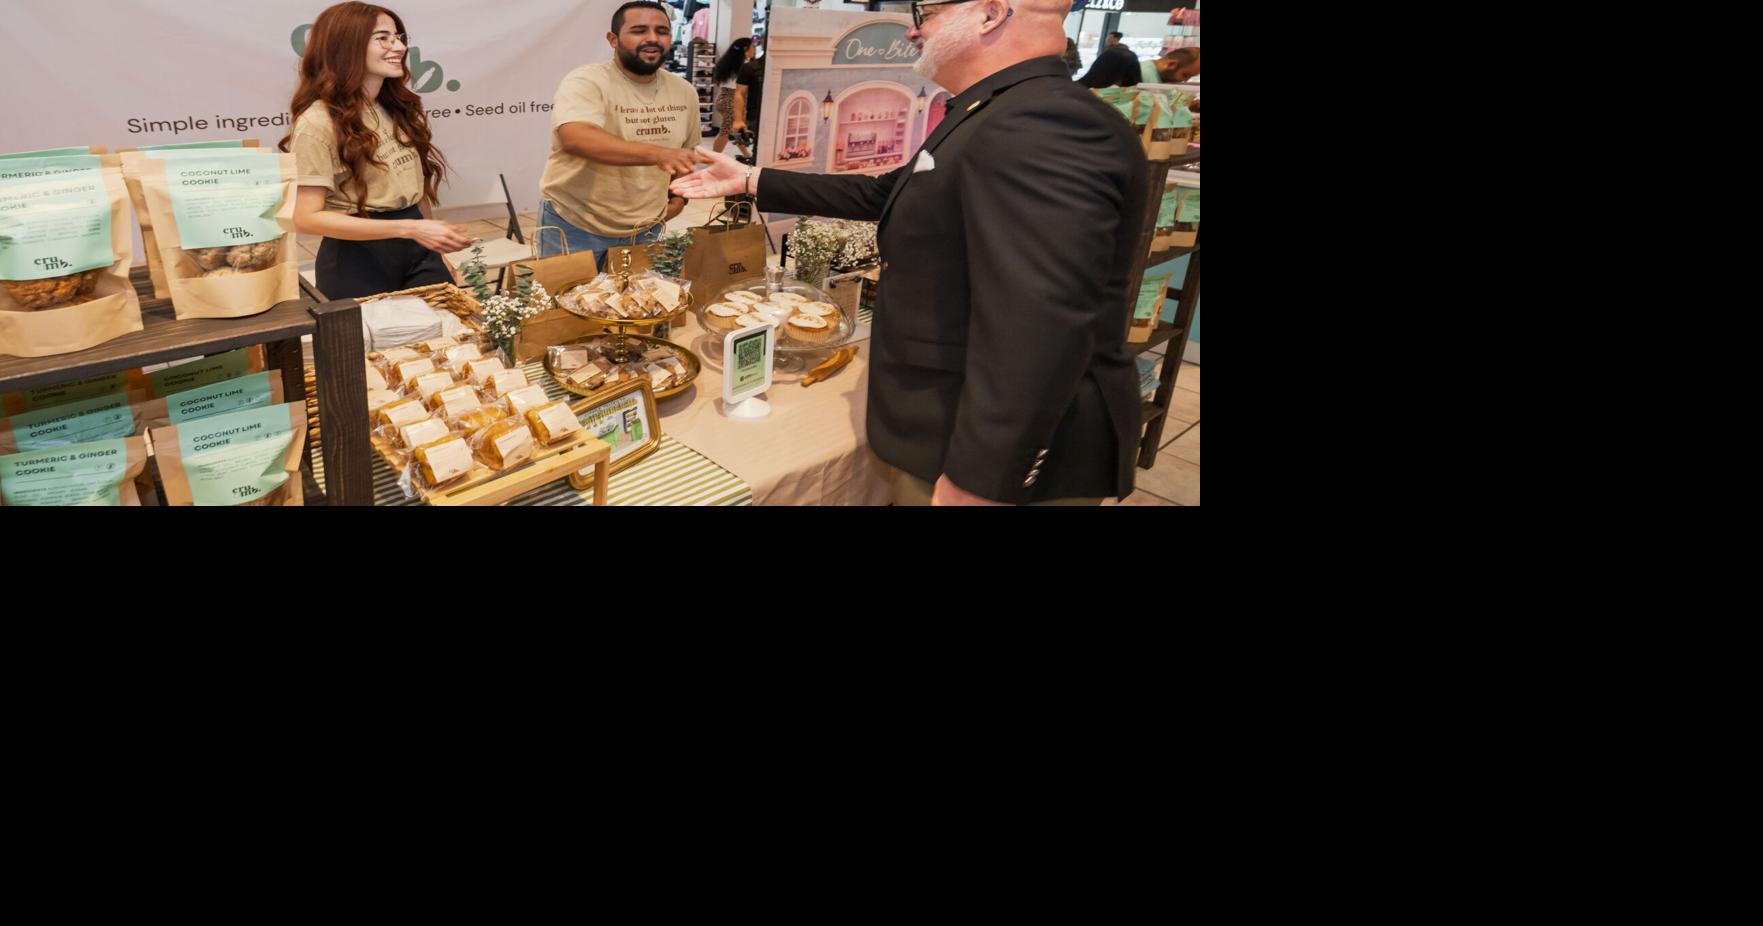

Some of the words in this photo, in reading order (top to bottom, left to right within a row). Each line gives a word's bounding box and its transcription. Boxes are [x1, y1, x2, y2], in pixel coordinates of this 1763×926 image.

[845, 38, 877, 59] One
[884, 39, 919, 59] Bite
[425, 107, 452, 119] ree
[465, 102, 504, 116] Seed
[508, 101, 526, 114] oil
[667, 104, 687, 112] things
[127, 116, 208, 135] Simple
[216, 112, 290, 132] ingredi
[625, 116, 639, 124] but
[636, 125, 671, 136] crumb.
[0, 170, 44, 179] RMERIC
[181, 169, 228, 177] COCONUT
[180, 393, 223, 407] COCONUT
[225, 388, 244, 398] LIME
[181, 402, 215, 415] COOKIE
[28, 413, 77, 430] TURMERIC
[30, 424, 68, 438] COOKIE
[193, 427, 240, 443] COCONUT
[242, 422, 262, 433] LIME
[194, 438, 231, 451] COOKIE
[14, 456, 68, 468] TURMERIC
[78, 449, 118, 460] GINGER
[16, 466, 56, 477] COOKIE
